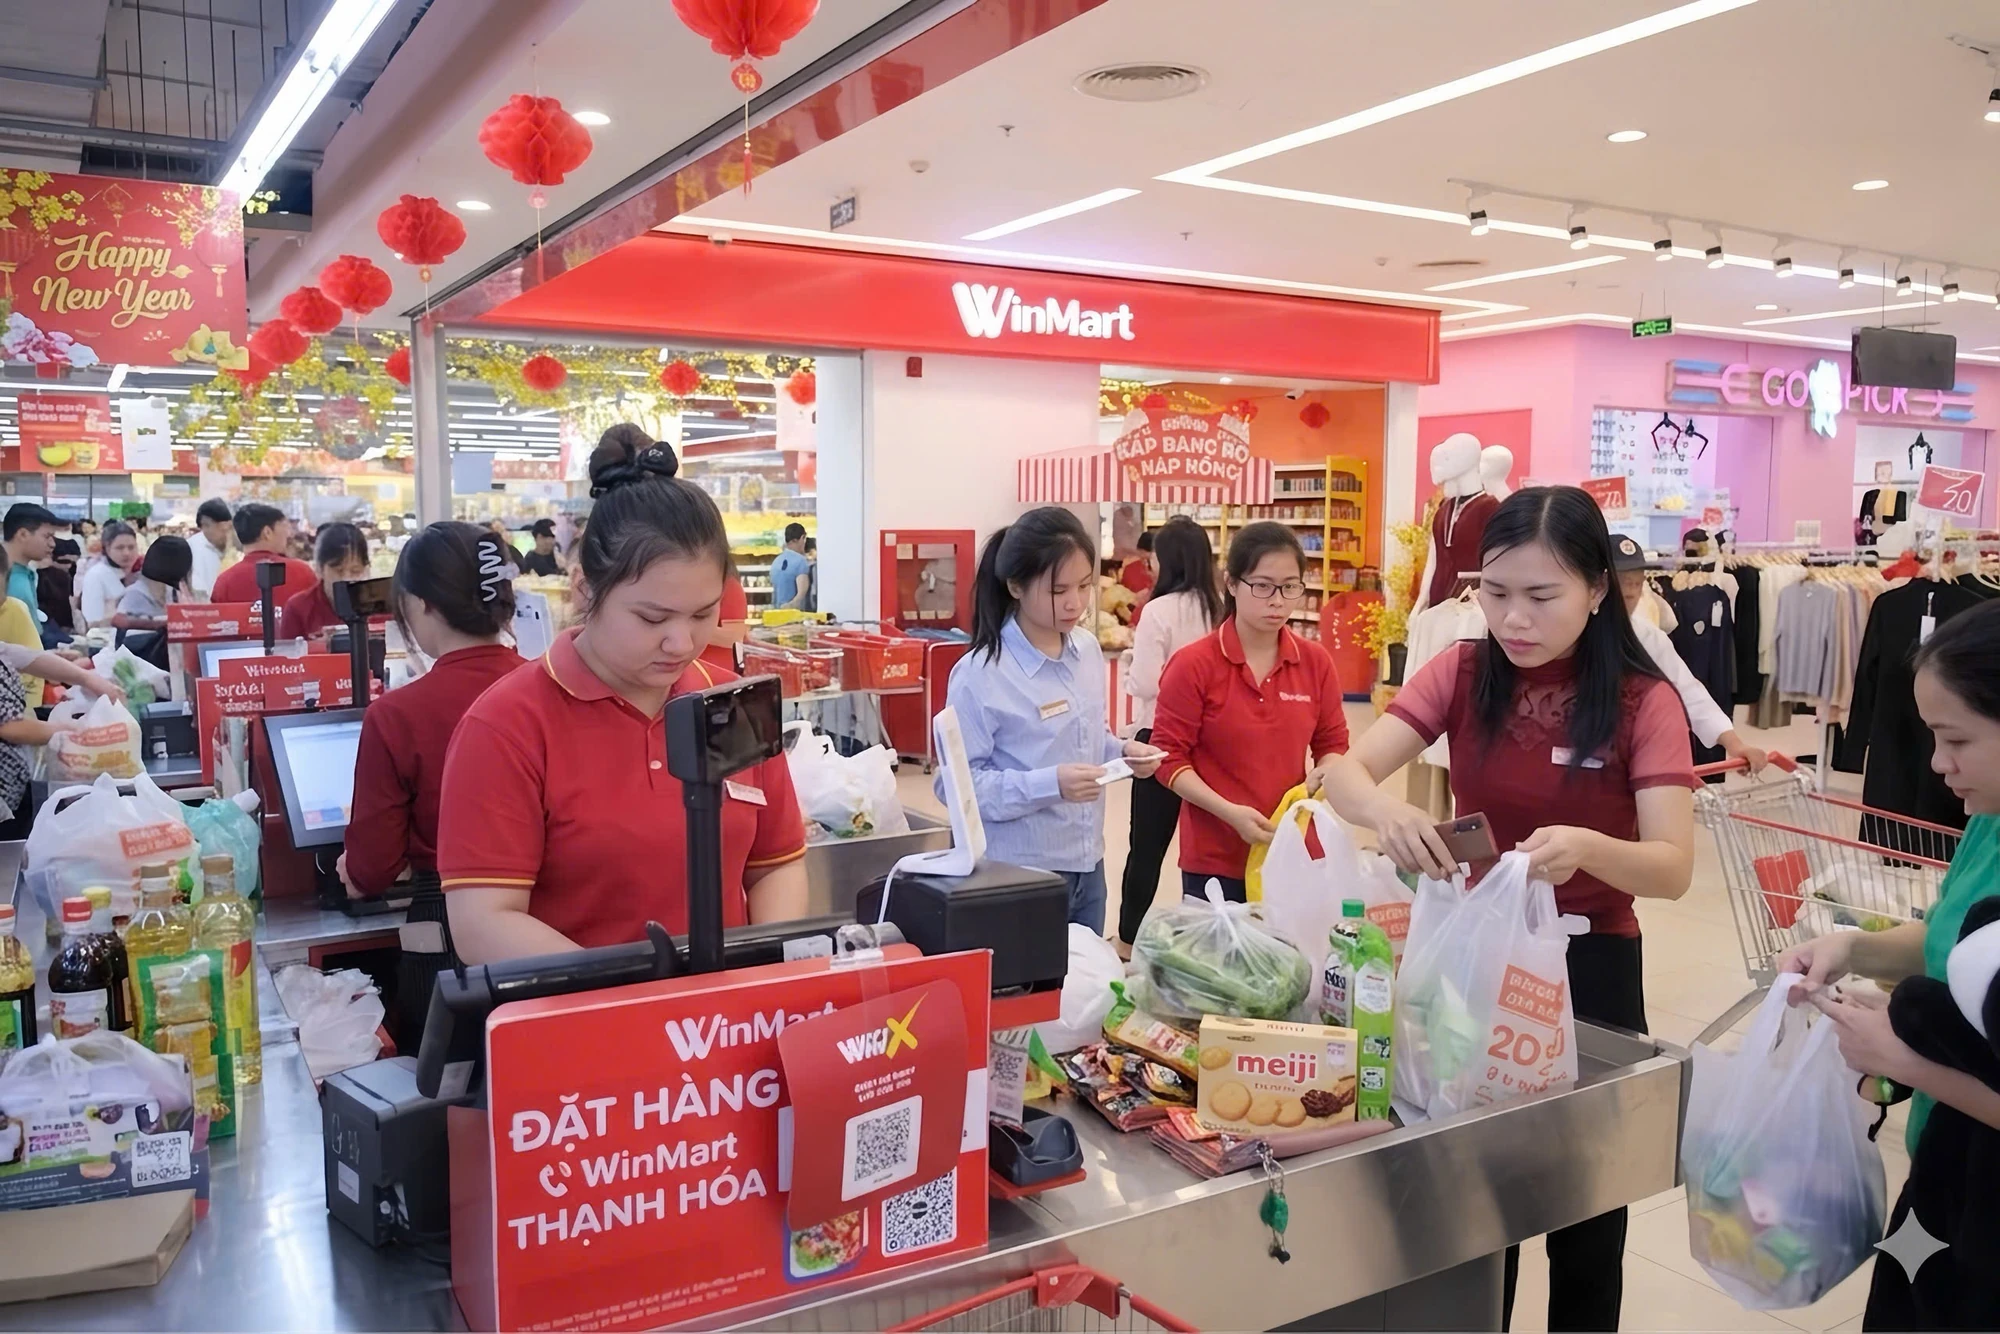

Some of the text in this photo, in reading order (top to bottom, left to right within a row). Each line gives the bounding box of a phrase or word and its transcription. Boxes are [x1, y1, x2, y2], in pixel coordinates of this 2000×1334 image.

[54, 231, 172, 278] Happy
[33, 275, 195, 329] New Year
[951, 281, 1136, 341] WinMart
[1762, 367, 1808, 407] GO
[1236, 1052, 1317, 1084] meiji
[1487, 1024, 1541, 1066] 20
[508, 1068, 780, 1152] ĐẶT HÀNG
[580, 1132, 738, 1187] WinMart
[508, 1165, 767, 1250] THẠNH HÓA
